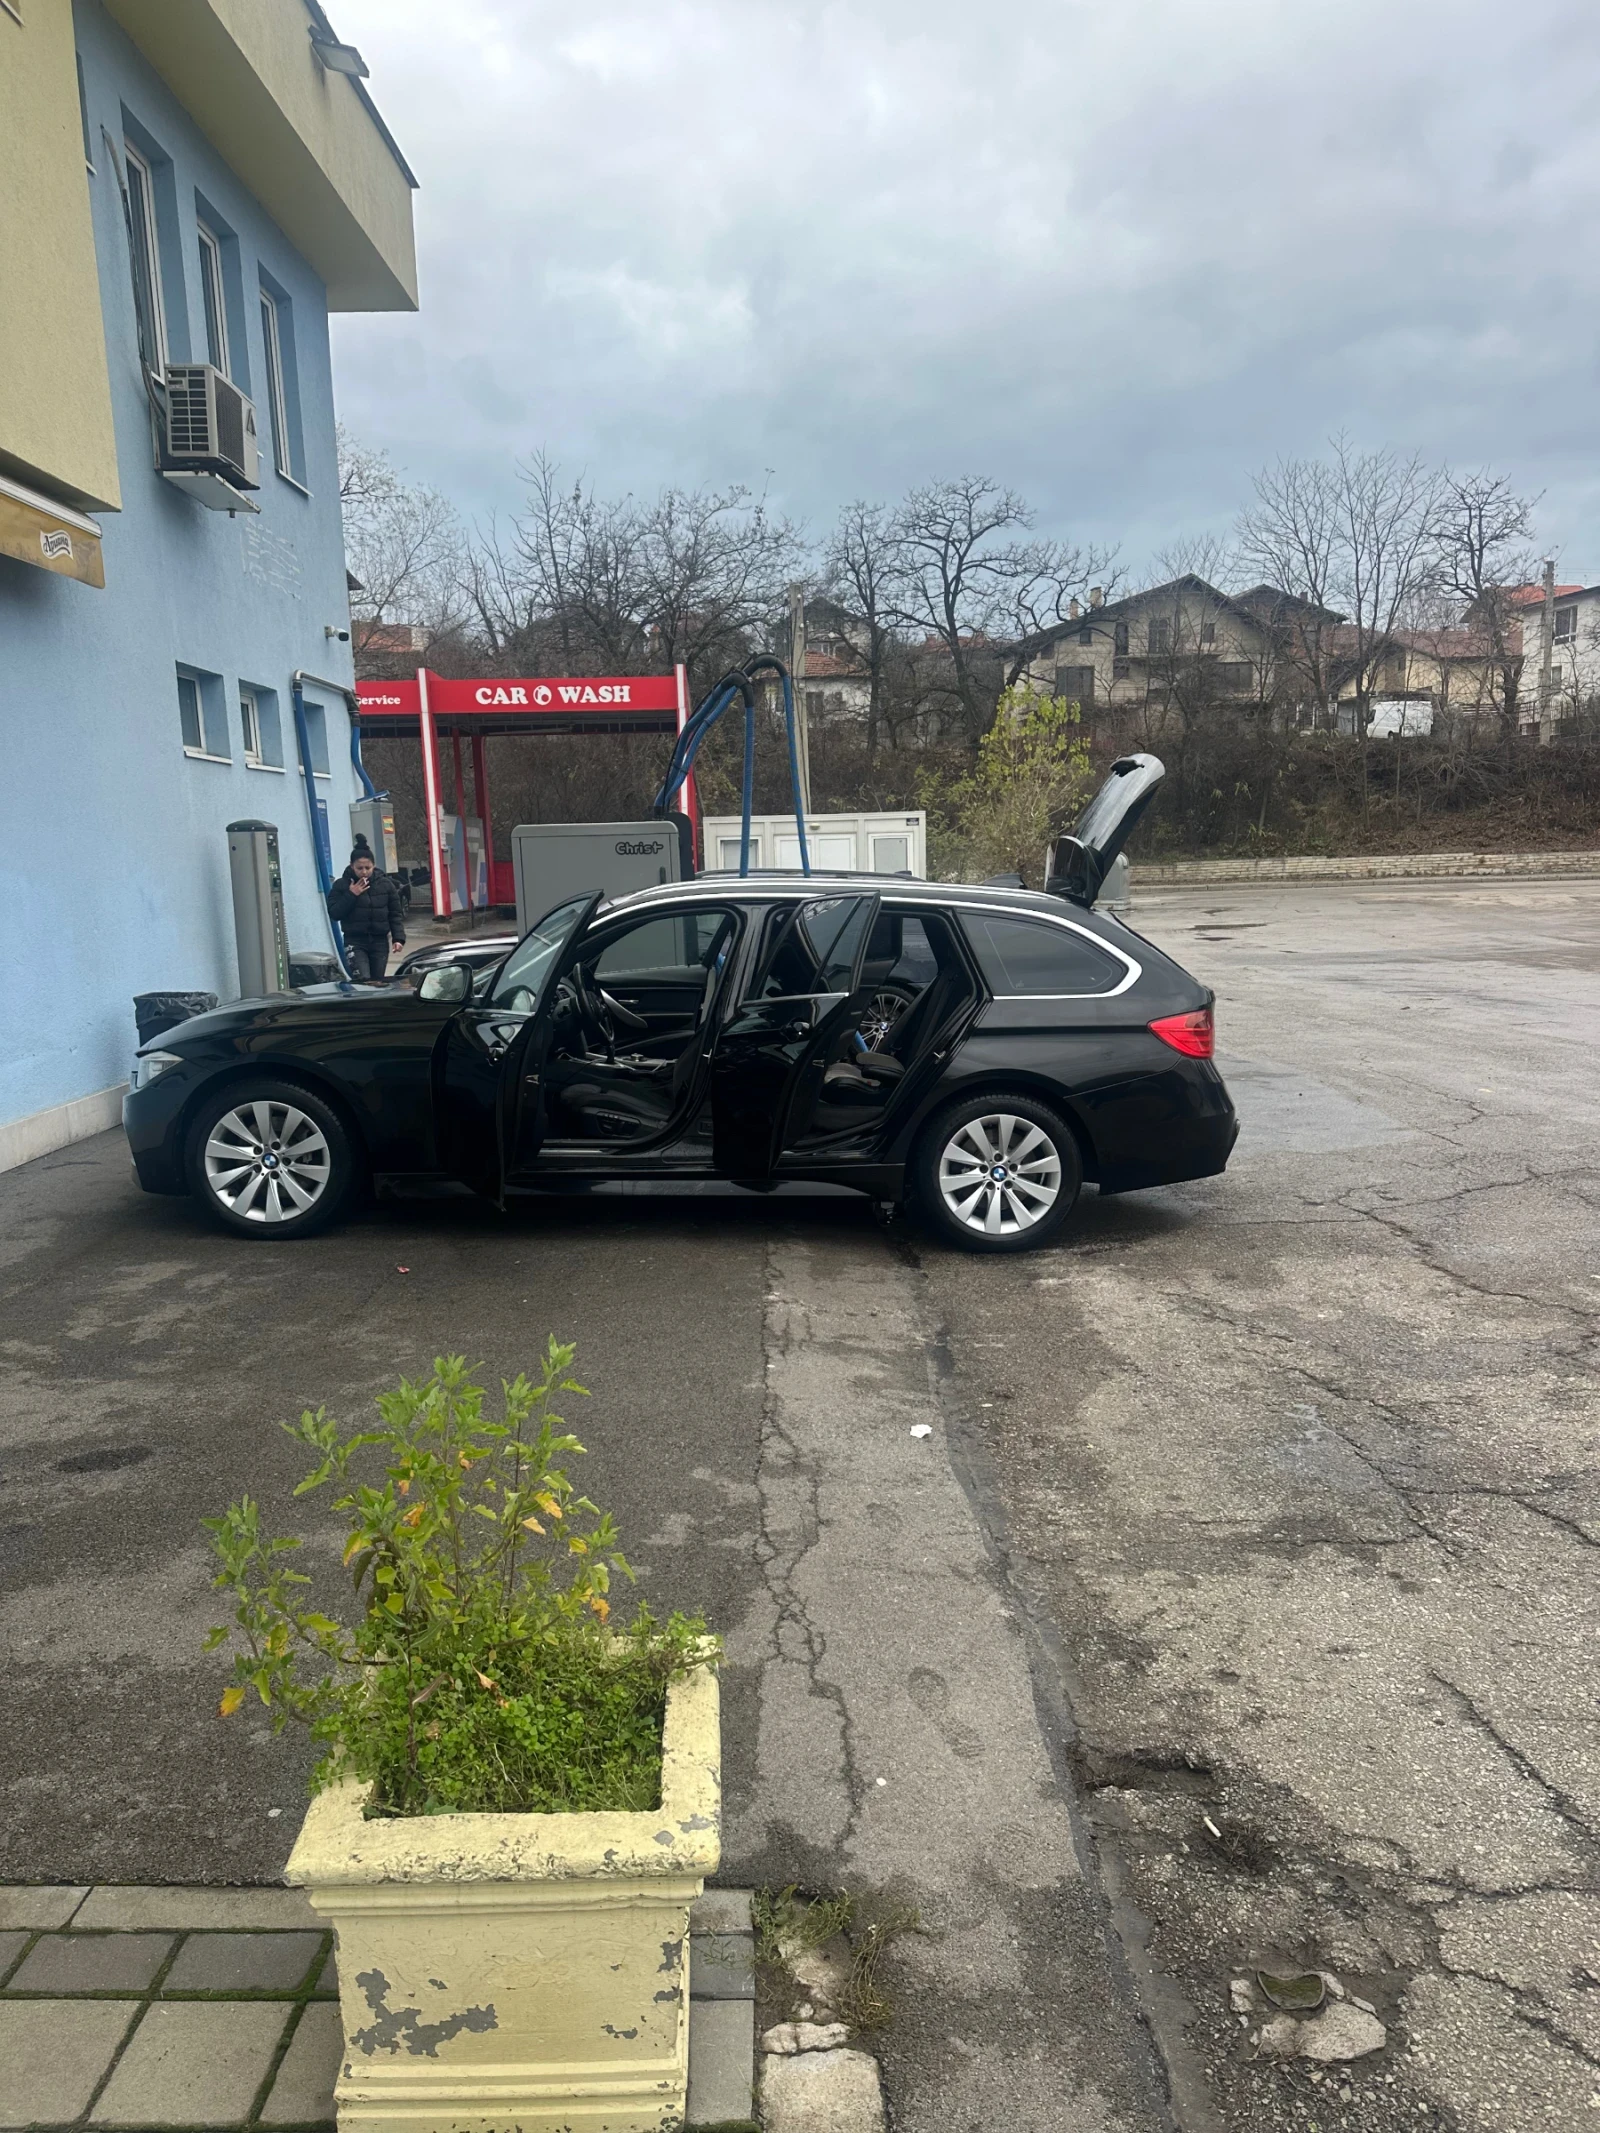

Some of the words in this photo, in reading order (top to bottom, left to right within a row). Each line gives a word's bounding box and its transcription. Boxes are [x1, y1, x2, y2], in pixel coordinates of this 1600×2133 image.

[475, 687, 529, 705] CAR
[557, 685, 631, 704] WASH
[615, 841, 664, 855] Christ
